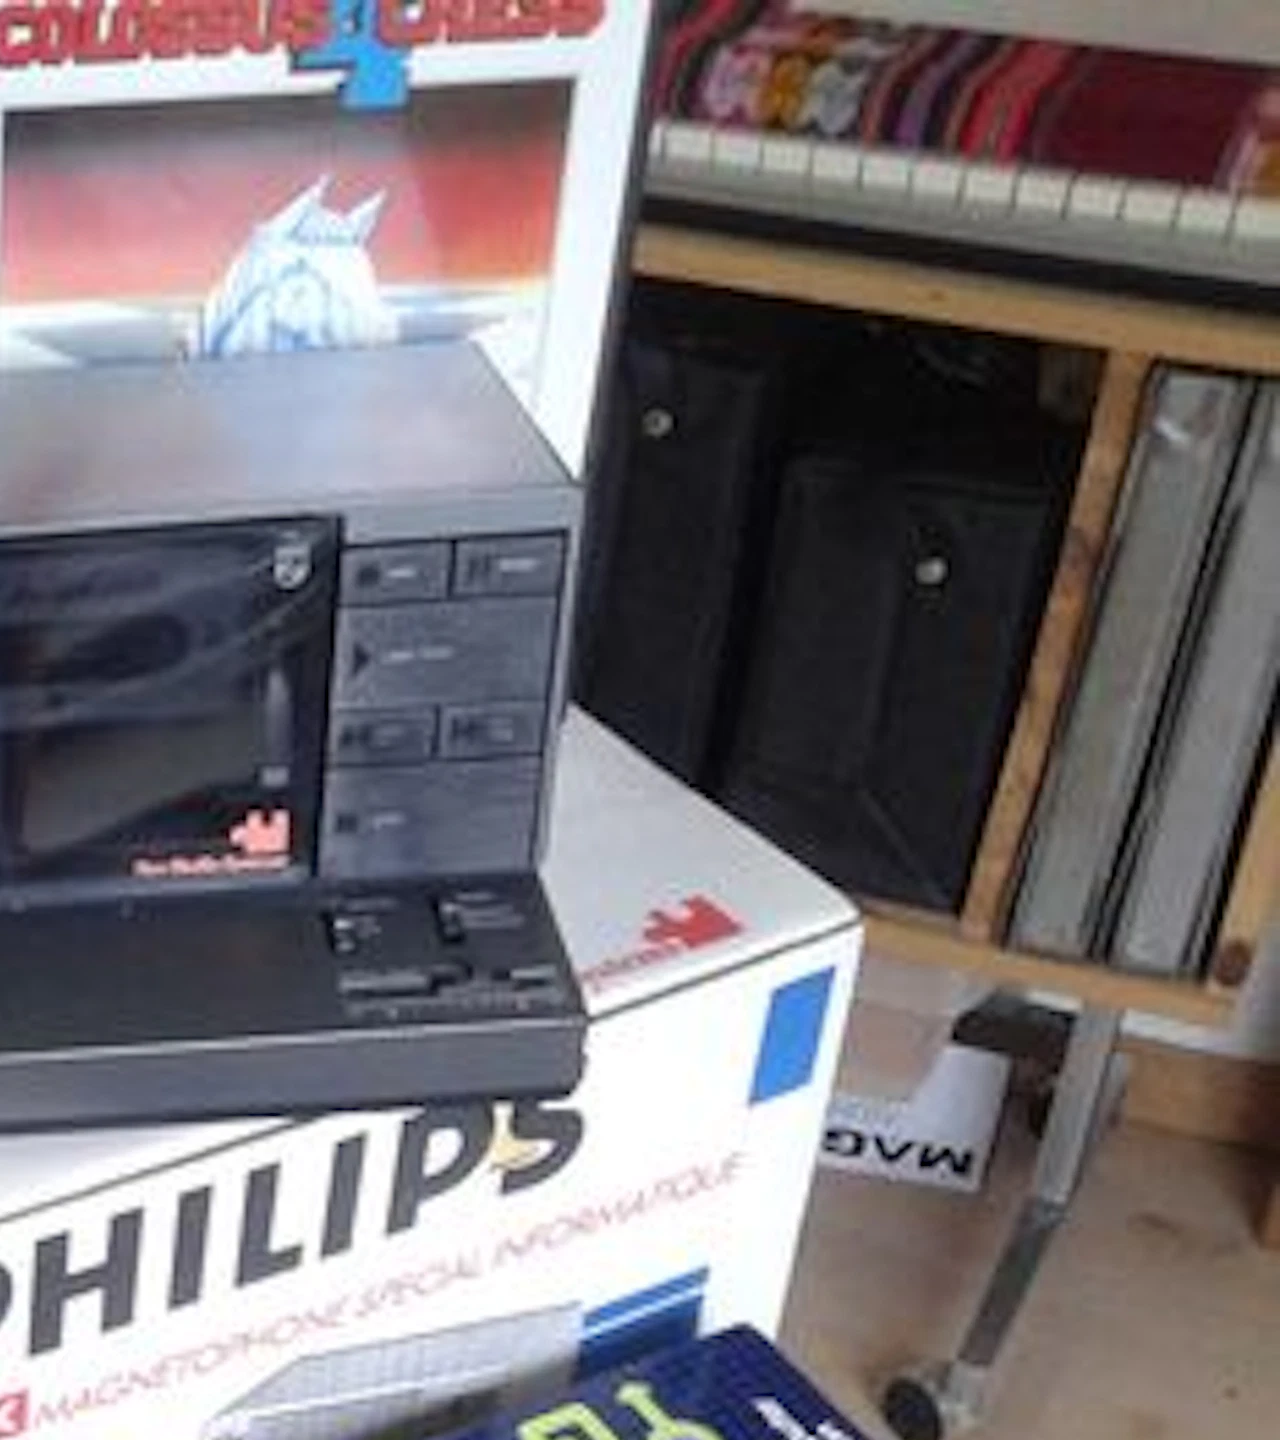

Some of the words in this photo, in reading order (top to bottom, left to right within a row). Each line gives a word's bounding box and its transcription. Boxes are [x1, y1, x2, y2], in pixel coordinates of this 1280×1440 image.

[36, 1302, 343, 1427] MAGNETOPHONE
[351, 1242, 484, 1320] SPECIAL
[494, 1152, 754, 1267] INFORMATIQUE
